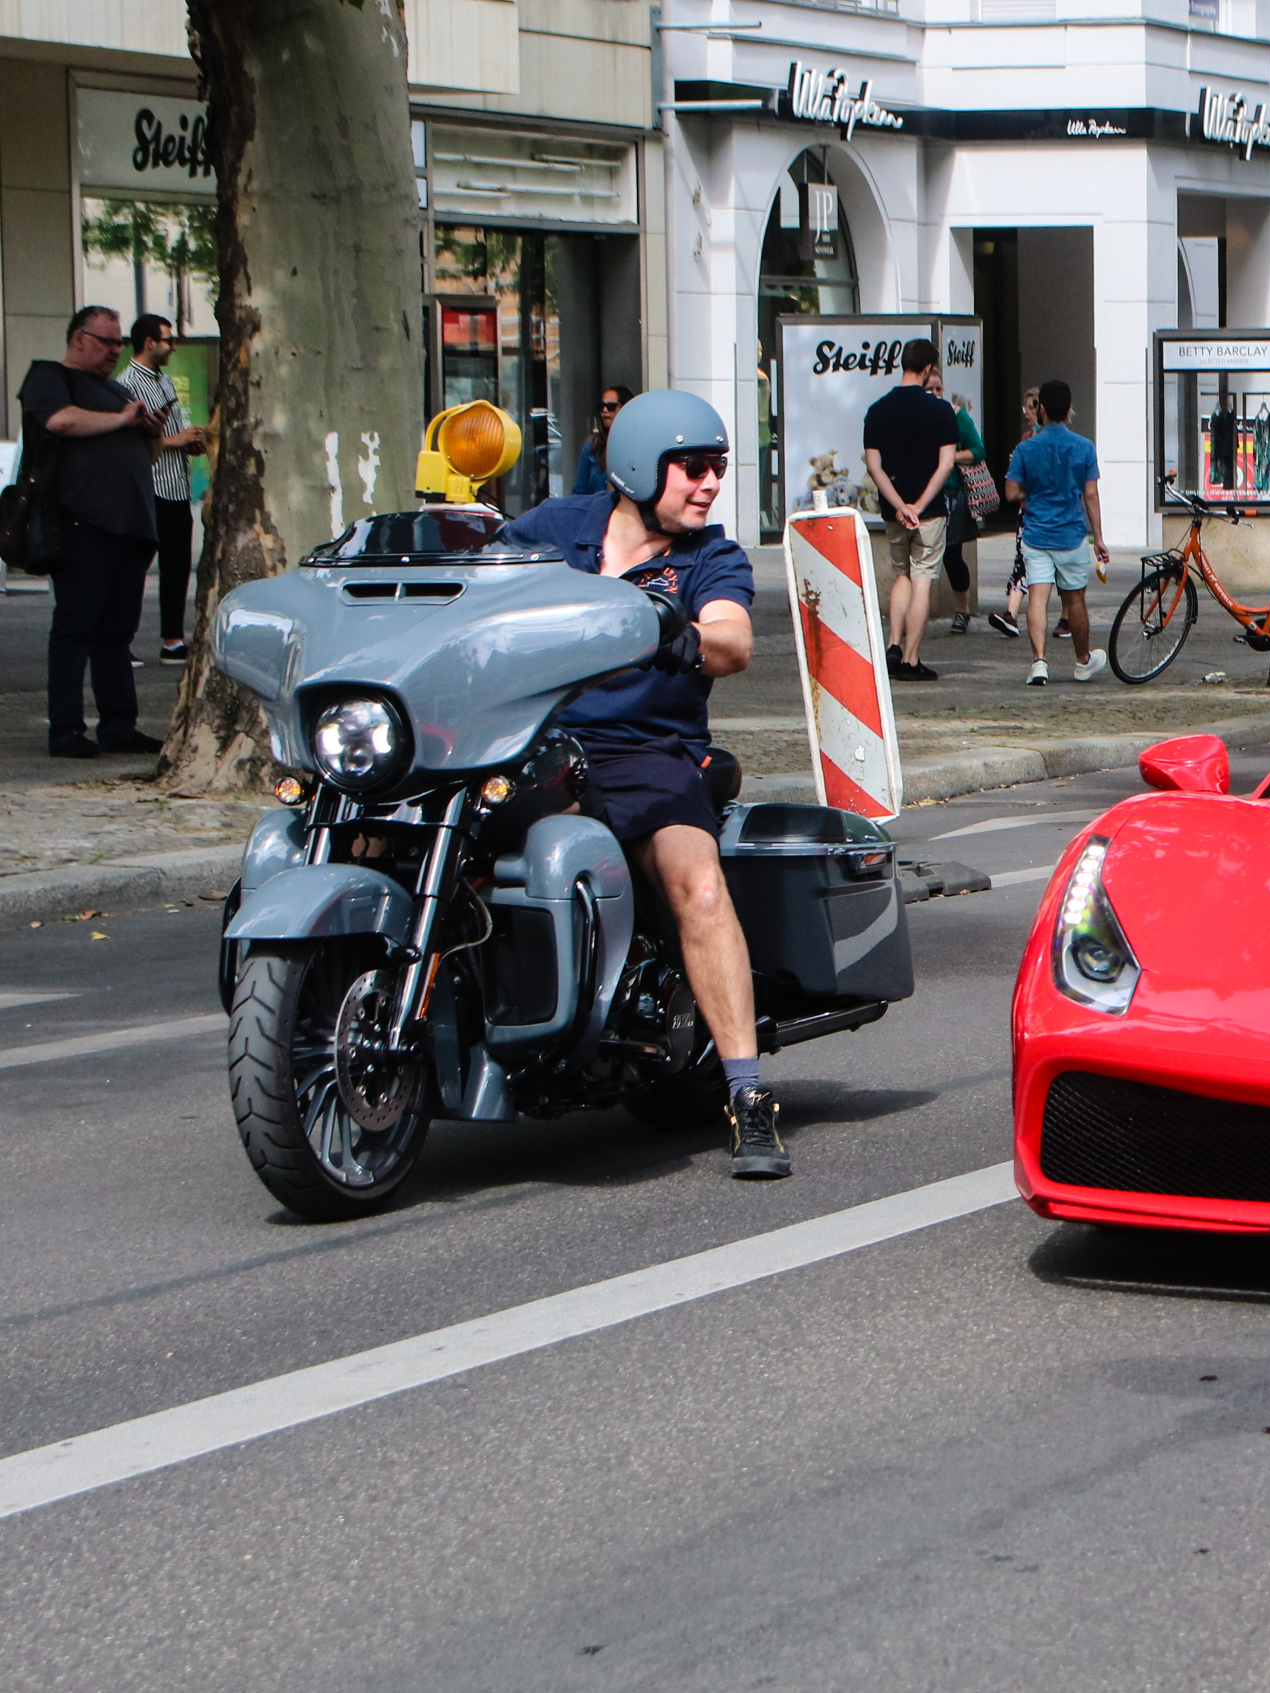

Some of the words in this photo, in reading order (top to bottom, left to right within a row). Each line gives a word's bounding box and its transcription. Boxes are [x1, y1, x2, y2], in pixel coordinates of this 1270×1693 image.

[790, 60, 832, 121] Ulla
[829, 67, 904, 141] Popken
[1201, 86, 1236, 141] Ulla
[1066, 119, 1087, 135] Ulla
[1088, 117, 1127, 139] Popken
[814, 190, 833, 244] JP
[813, 340, 902, 377] Steiff
[947, 340, 975, 368] Steiff
[1178, 346, 1213, 357] BETTY
[1216, 346, 1268, 357] BARCLAY
